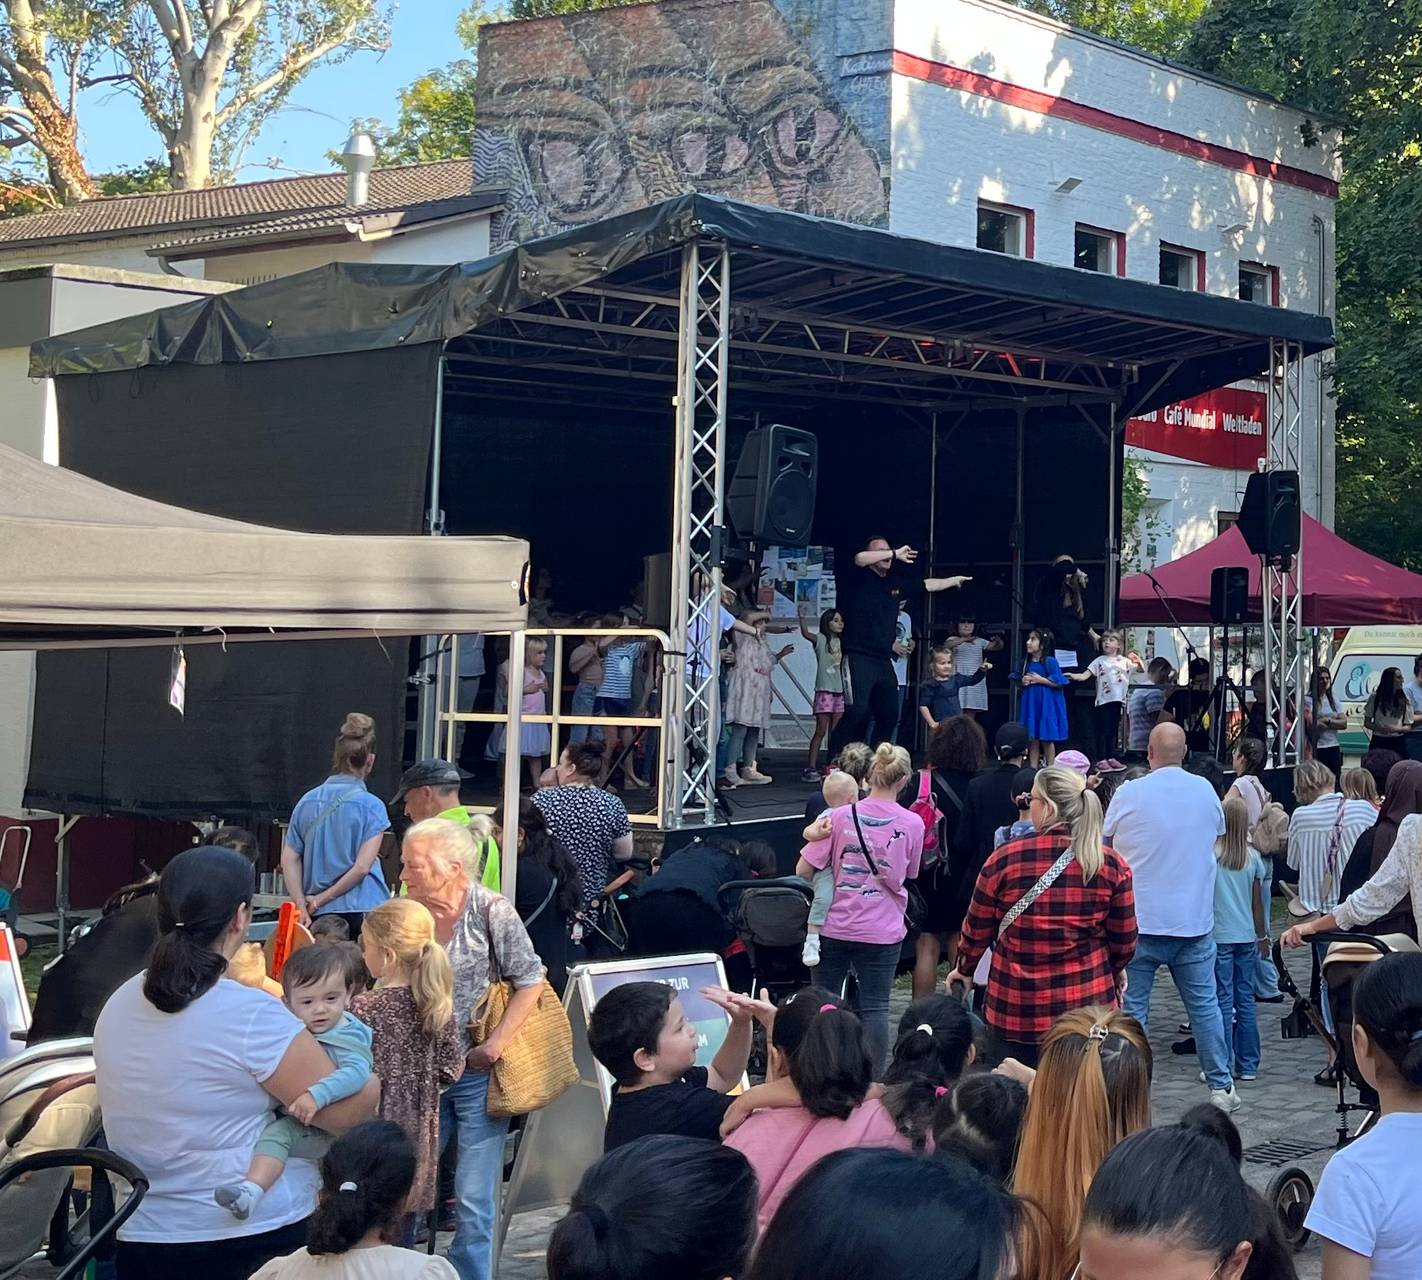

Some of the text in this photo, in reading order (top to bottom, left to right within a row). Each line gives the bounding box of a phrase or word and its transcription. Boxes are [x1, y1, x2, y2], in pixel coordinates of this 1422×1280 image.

[1164, 405, 1182, 426] Café
[1184, 408, 1216, 430] Mundial
[1222, 413, 1263, 435] Weltladen
